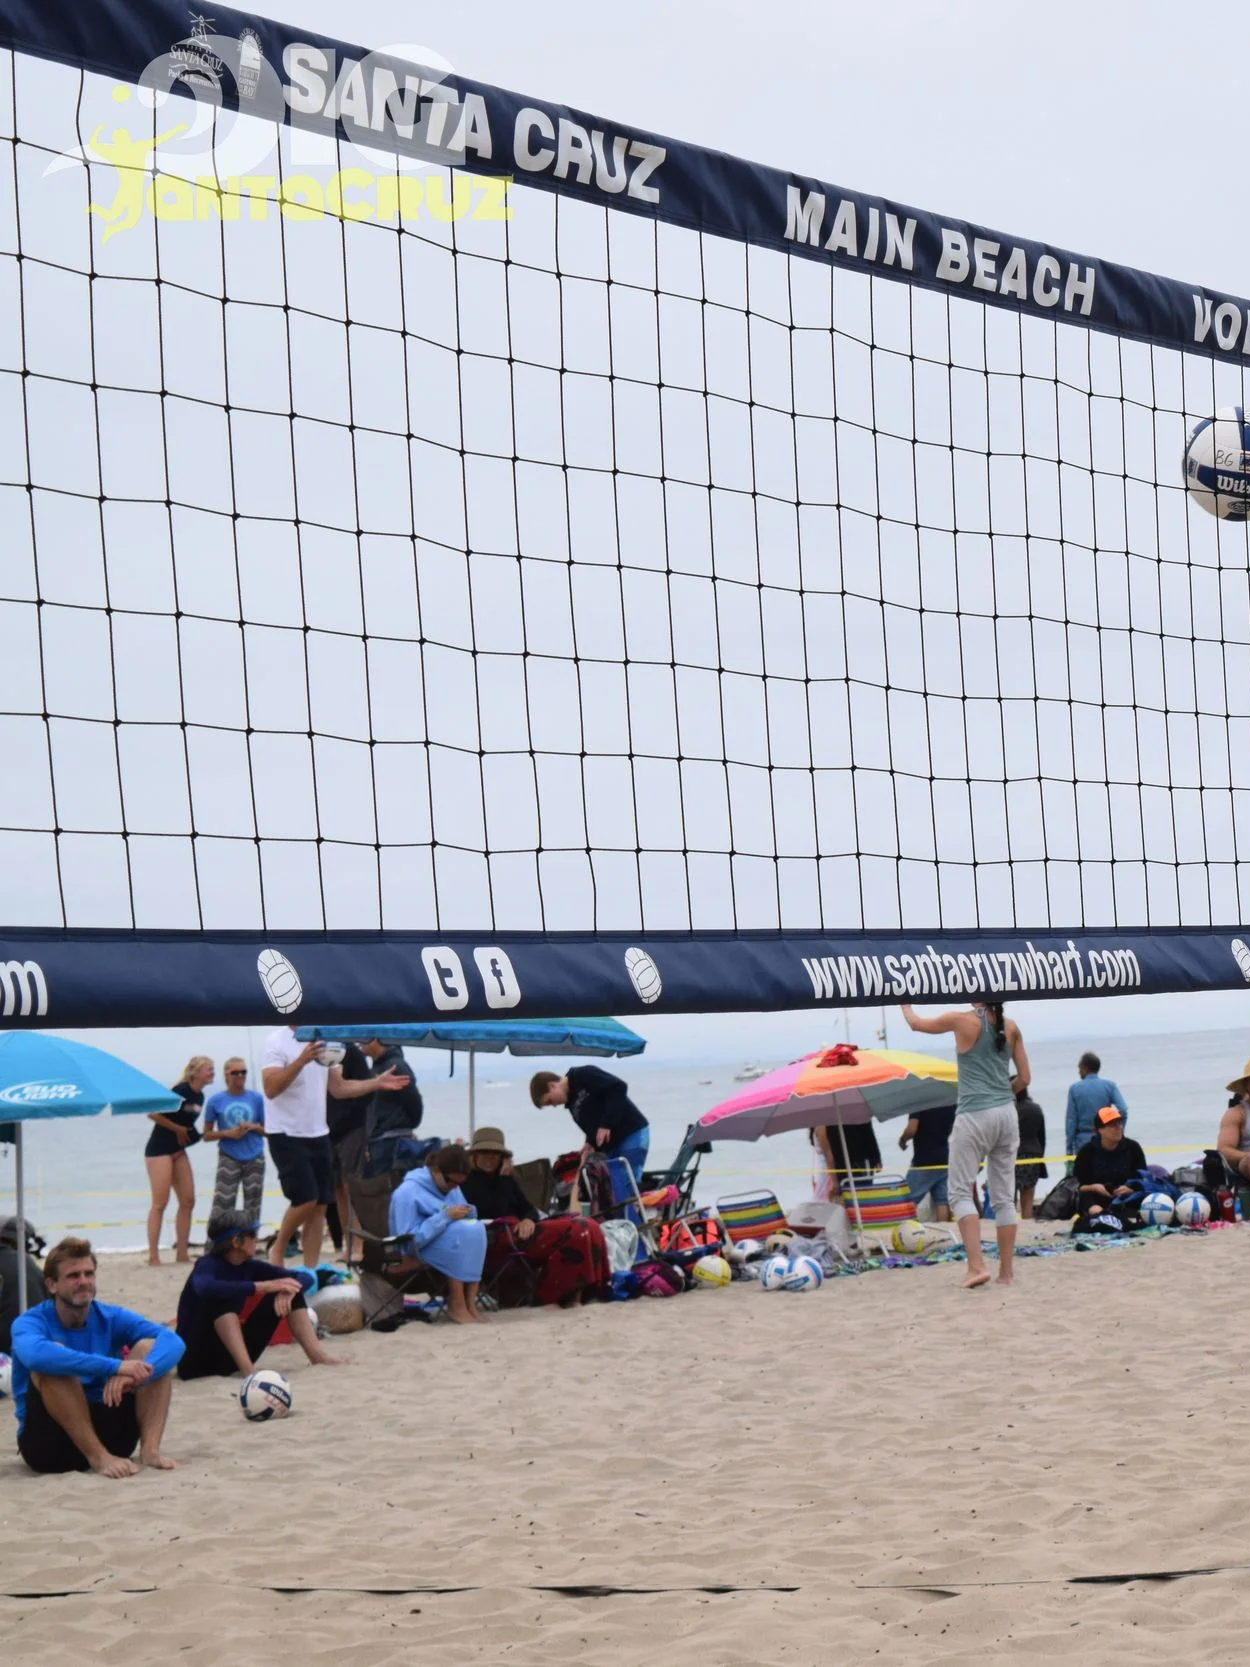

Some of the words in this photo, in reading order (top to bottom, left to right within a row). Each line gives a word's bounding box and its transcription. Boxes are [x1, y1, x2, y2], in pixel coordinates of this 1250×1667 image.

[282, 43, 493, 160] SANTA
[512, 107, 667, 203] CRUZ
[784, 185, 917, 271] MAIN
[936, 227, 1096, 316] BEACH
[1215, 450, 1234, 467] BG
[0, 960, 48, 1016] m
[802, 940, 1141, 999] www.santacruzwharf.com
